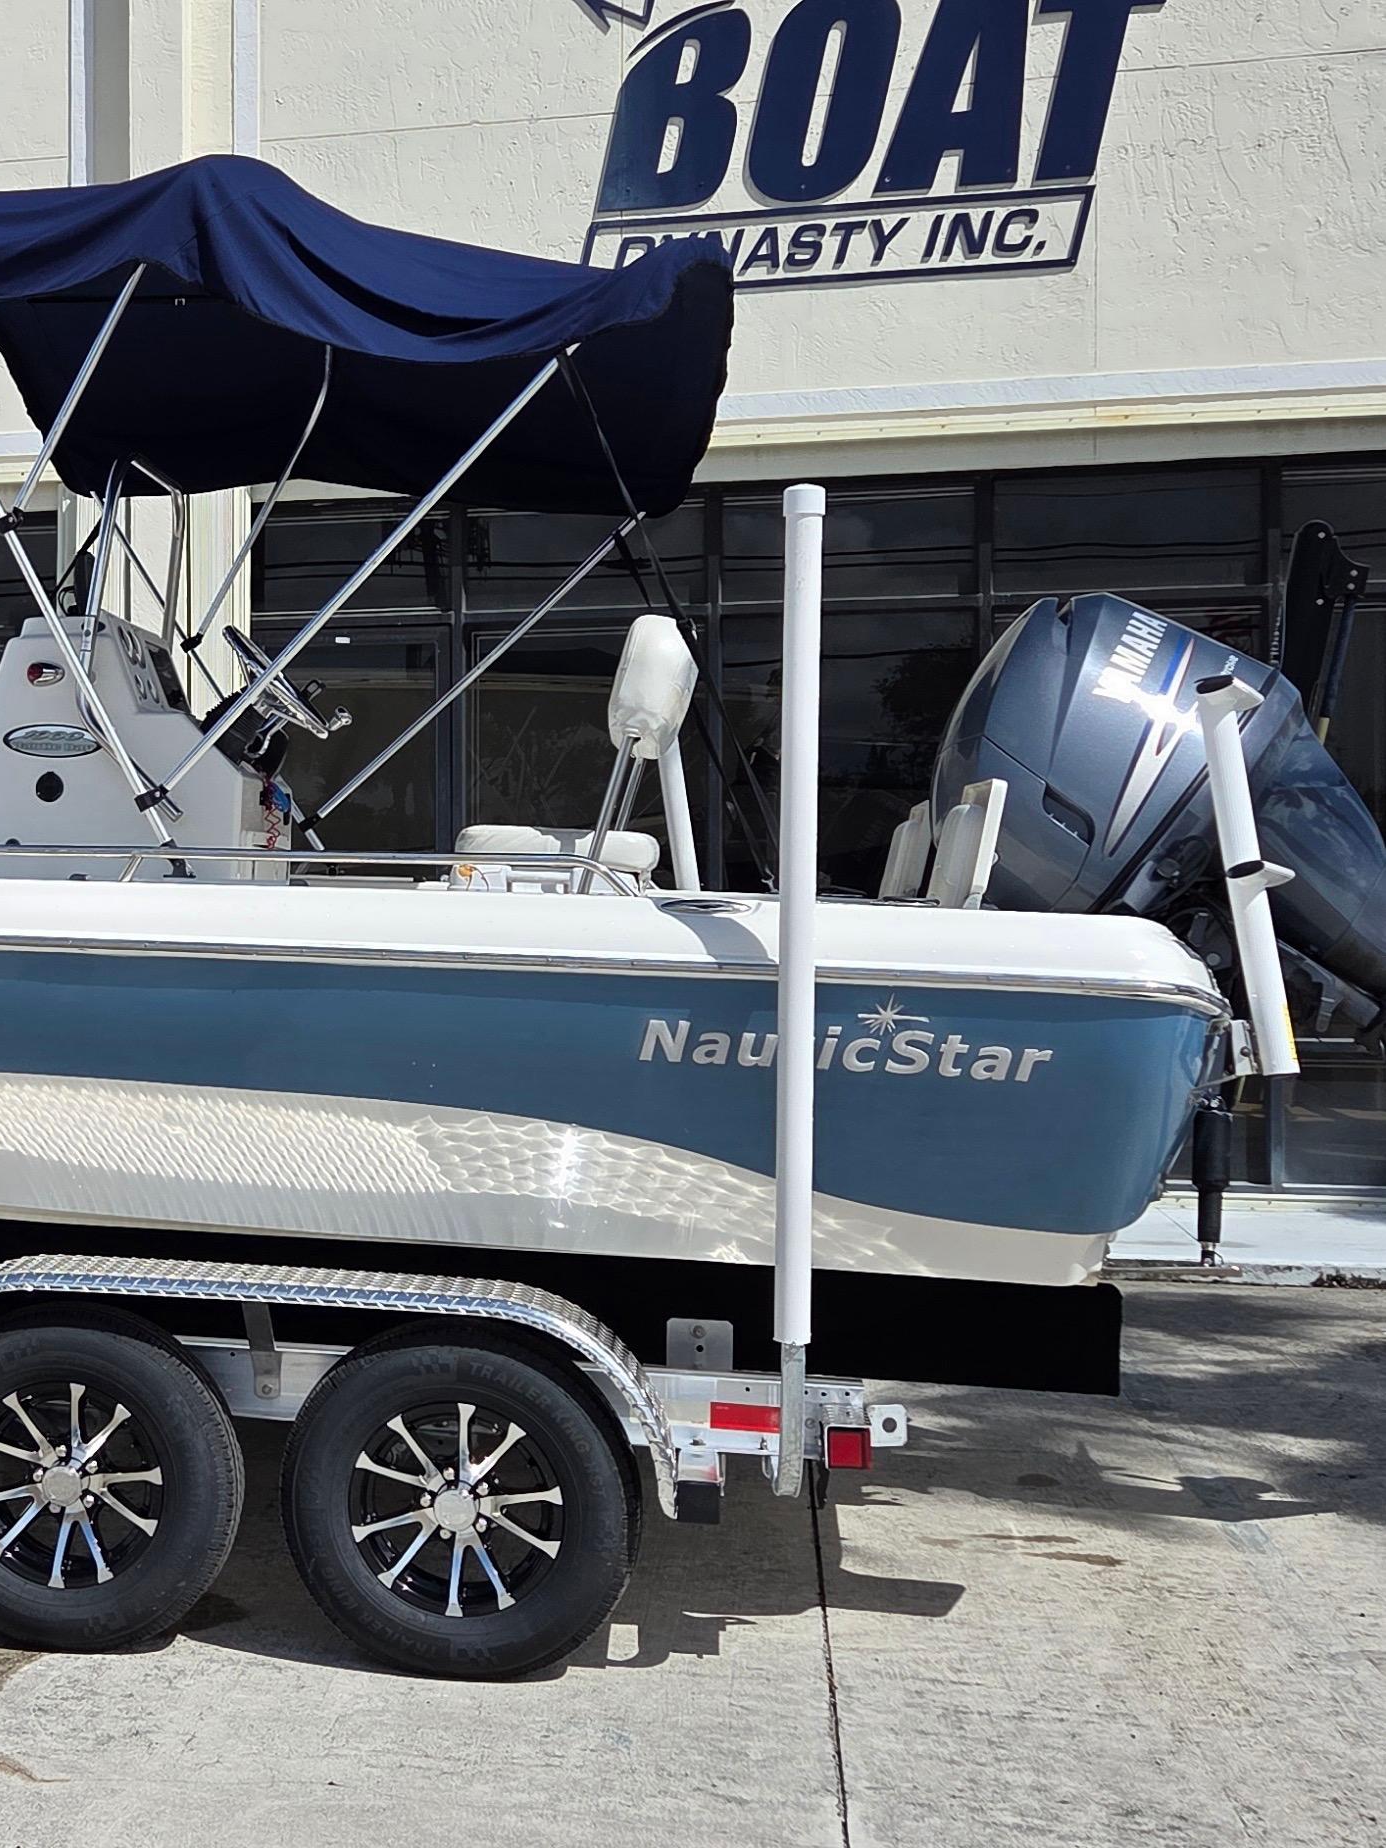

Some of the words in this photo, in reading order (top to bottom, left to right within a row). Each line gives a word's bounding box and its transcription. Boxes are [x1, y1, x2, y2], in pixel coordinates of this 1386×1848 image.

[597, 0, 1164, 213] BOAT
[614, 217, 911, 276] DASTY
[922, 208, 1047, 262] INC.
[1092, 611, 1168, 704] YAMAHA
[639, 1018, 1053, 1083] NauicStar
